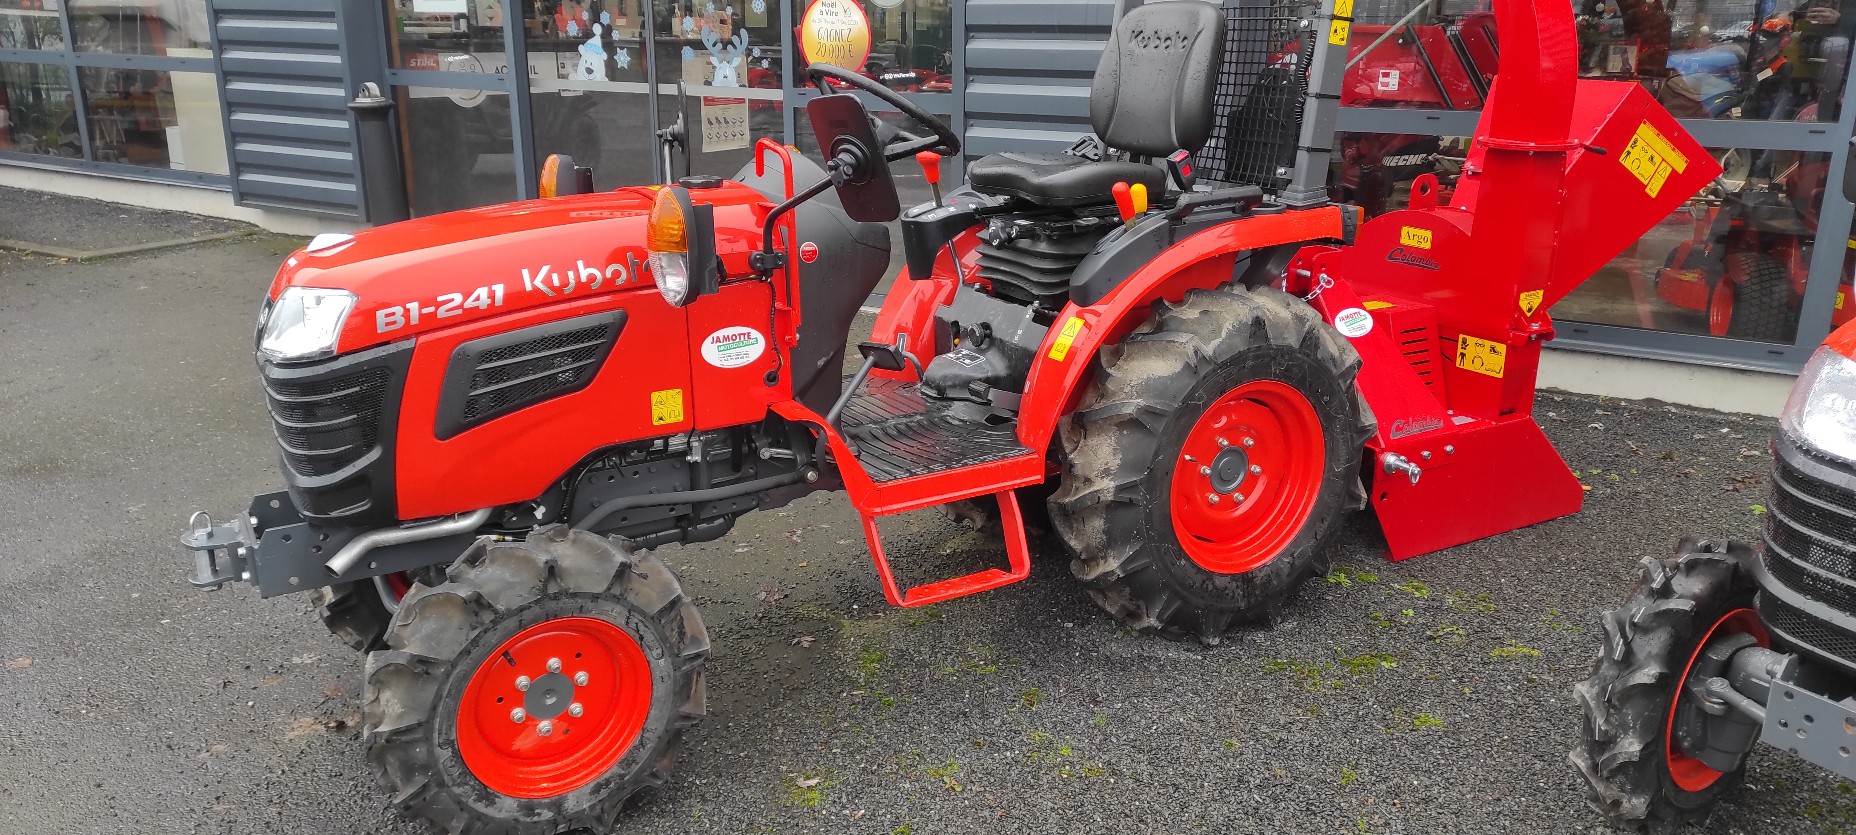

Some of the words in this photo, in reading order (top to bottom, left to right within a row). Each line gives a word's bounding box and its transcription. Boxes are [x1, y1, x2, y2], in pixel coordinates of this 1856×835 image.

[818, 27, 852, 42] GAGNEZ
[1404, 230, 1429, 245] Argo
[376, 283, 504, 333] B1-241
[711, 332, 752, 344] JAMOTTE
